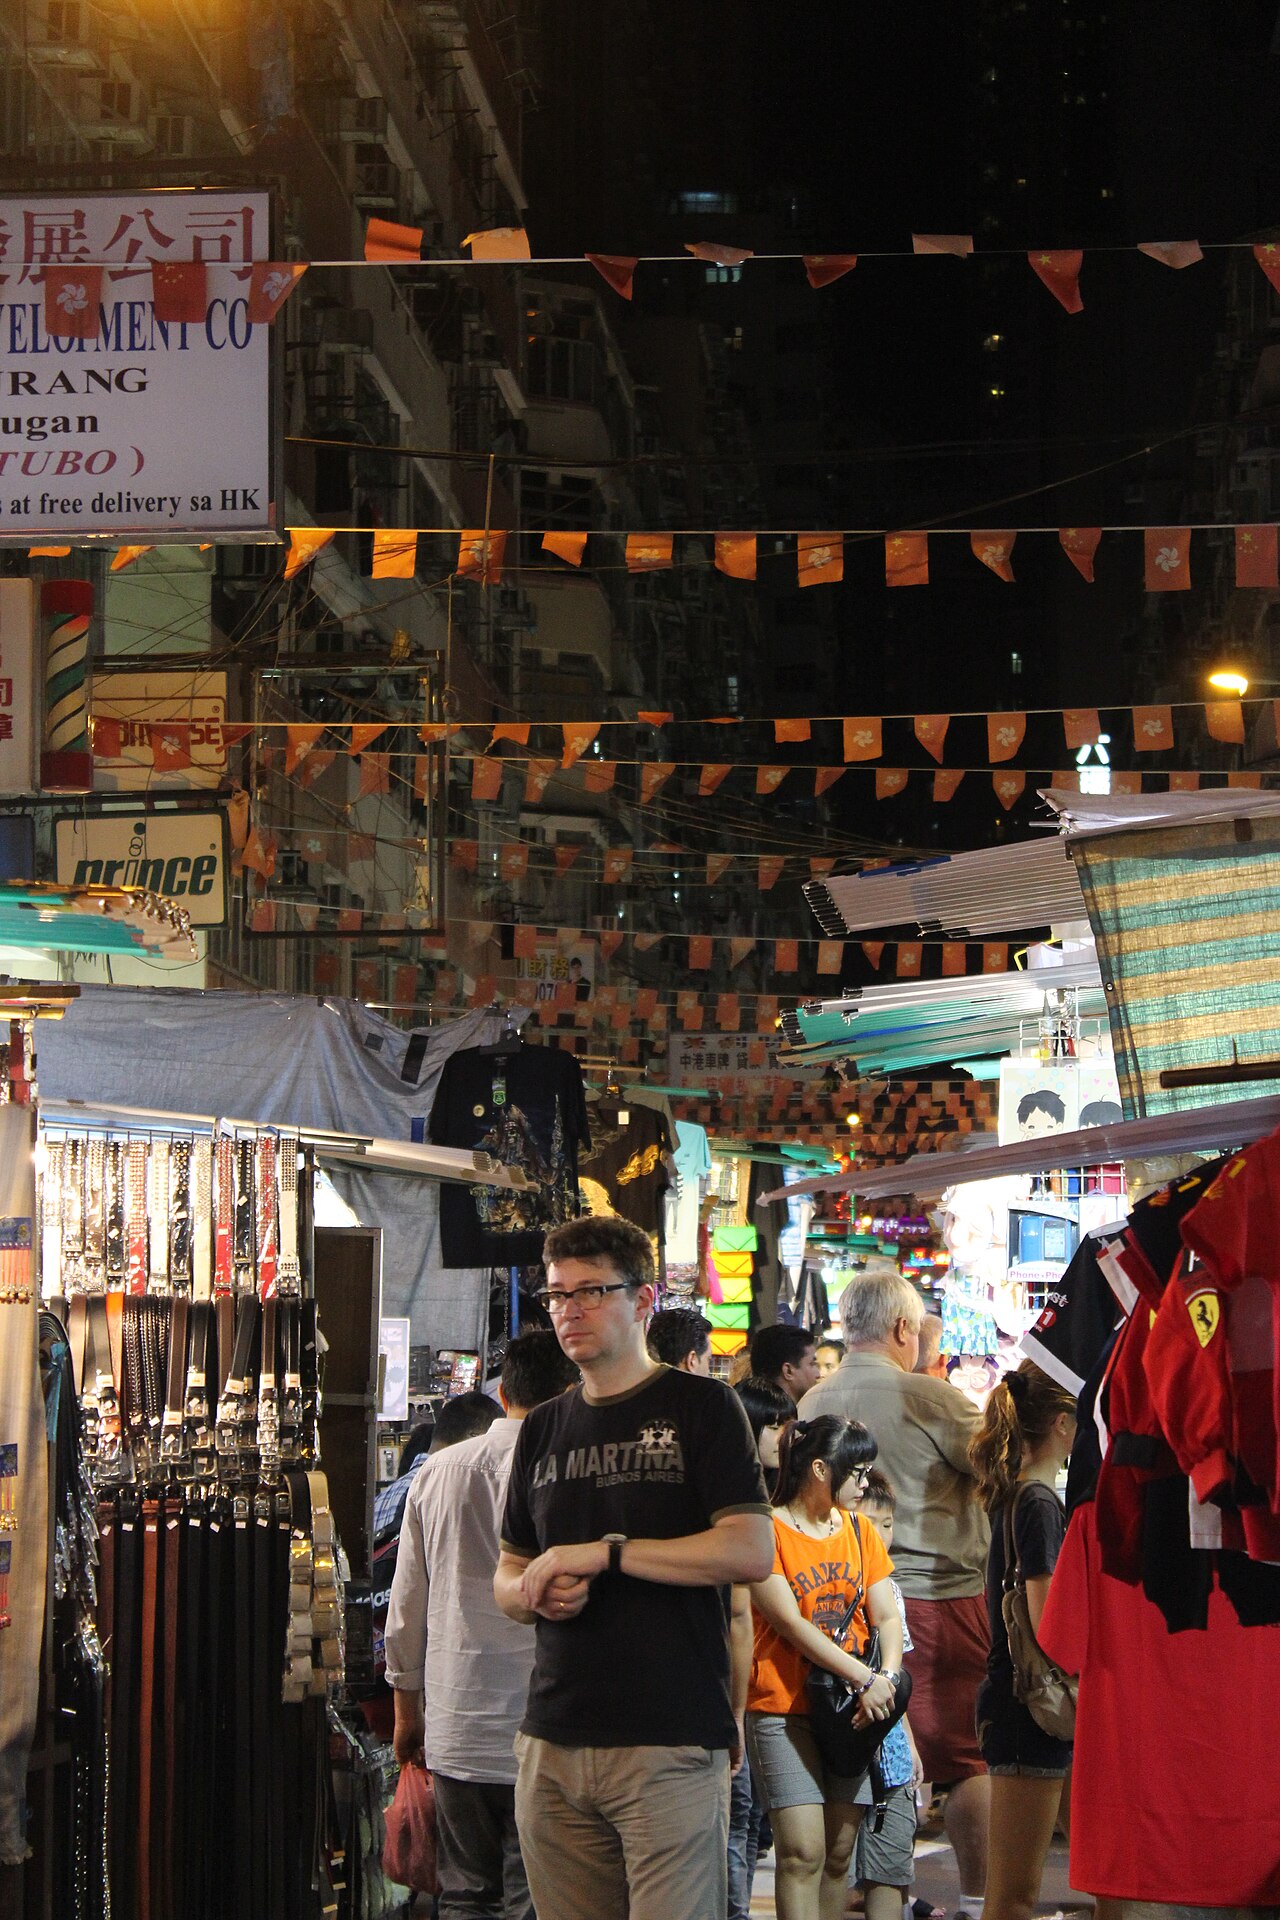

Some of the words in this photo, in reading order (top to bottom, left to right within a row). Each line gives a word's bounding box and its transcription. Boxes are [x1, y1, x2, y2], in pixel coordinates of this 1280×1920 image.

[205, 298, 252, 350] CO
[0, 367, 149, 396] RANG
[0, 415, 100, 441] ugan
[10, 498, 31, 516] at
[39, 493, 83, 515] free
[91, 492, 182, 518] delivery
[189, 494, 213, 512] sa
[219, 488, 261, 512] HK
[679, 1052, 729, 1071] 中港車牌
[532, 1454, 558, 1488] LA
[564, 1441, 685, 1480] MARTINA
[595, 1471, 641, 1488] BUENOS
[645, 1470, 685, 1484] AIRES
